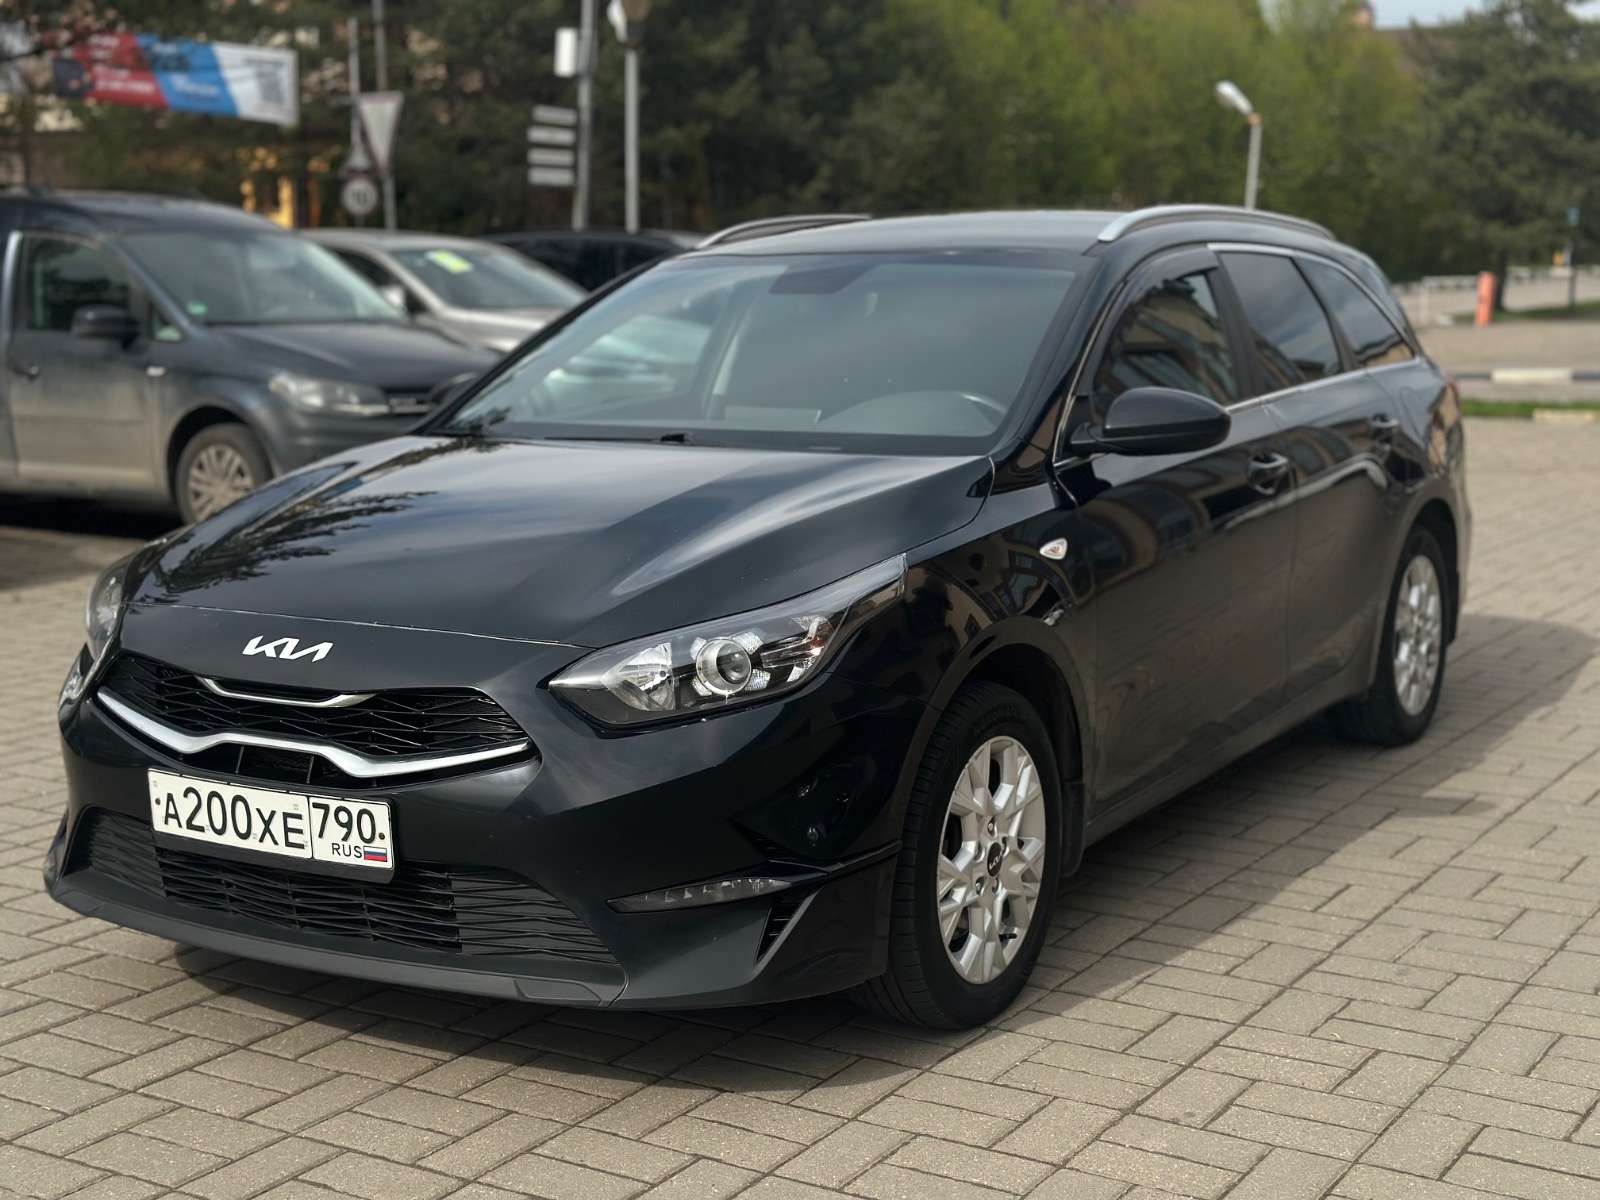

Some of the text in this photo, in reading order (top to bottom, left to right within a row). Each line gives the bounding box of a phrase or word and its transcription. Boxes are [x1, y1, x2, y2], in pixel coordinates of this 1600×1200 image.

[242, 635, 333, 662] KIA
[312, 802, 377, 844] 790
[331, 842, 362, 858] RUS
